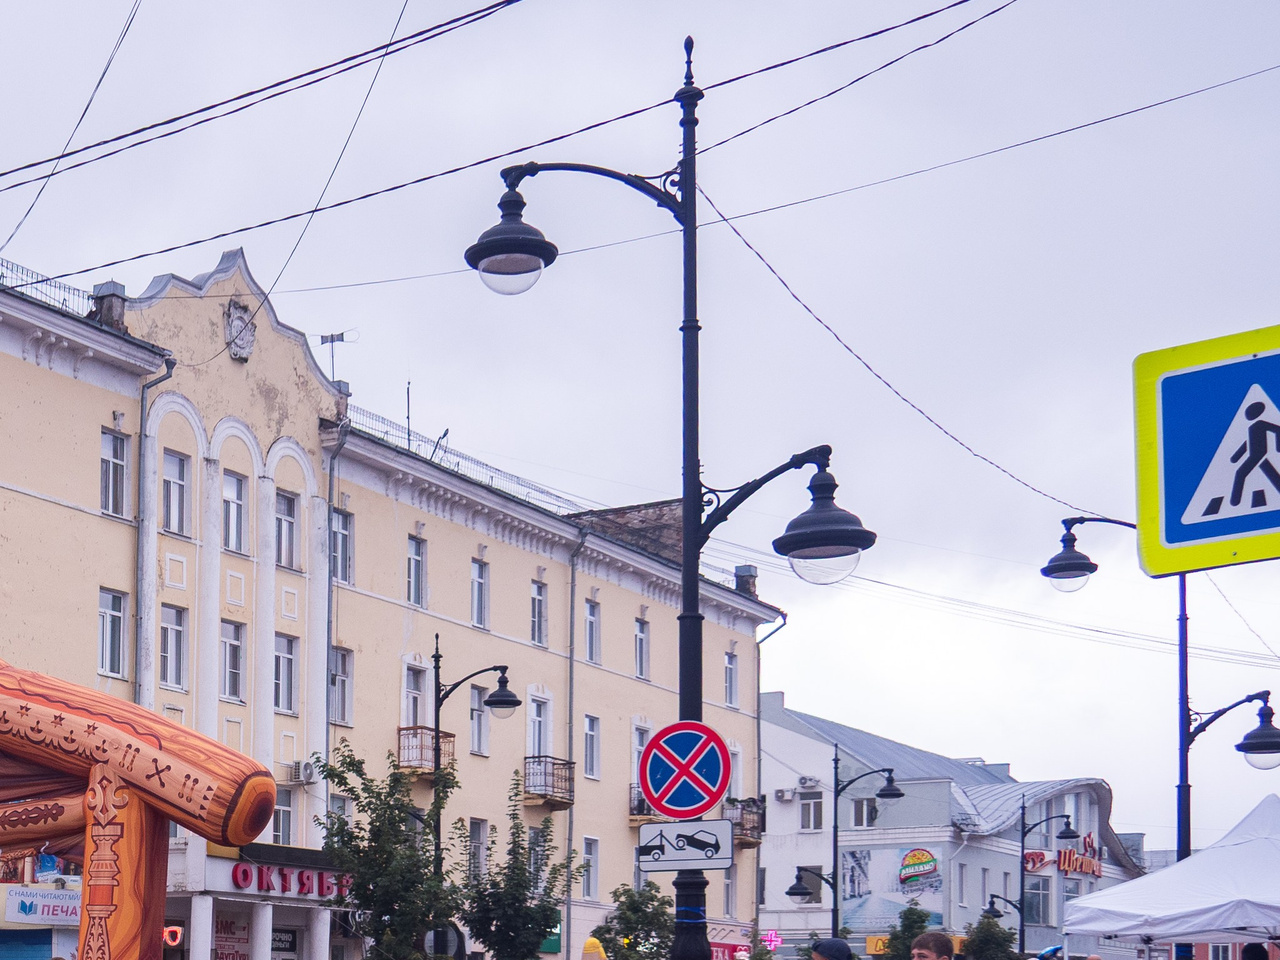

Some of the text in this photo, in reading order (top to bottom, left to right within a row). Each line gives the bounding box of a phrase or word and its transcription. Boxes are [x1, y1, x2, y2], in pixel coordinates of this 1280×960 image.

[232, 862, 354, 897] ОКТЯБР
[14, 890, 38, 899] НАМИ
[38, 892, 68, 901] ЧИТАЮТ
[41, 903, 82, 917] ПЕЧА
[272, 932, 292, 941] РОЧНО
